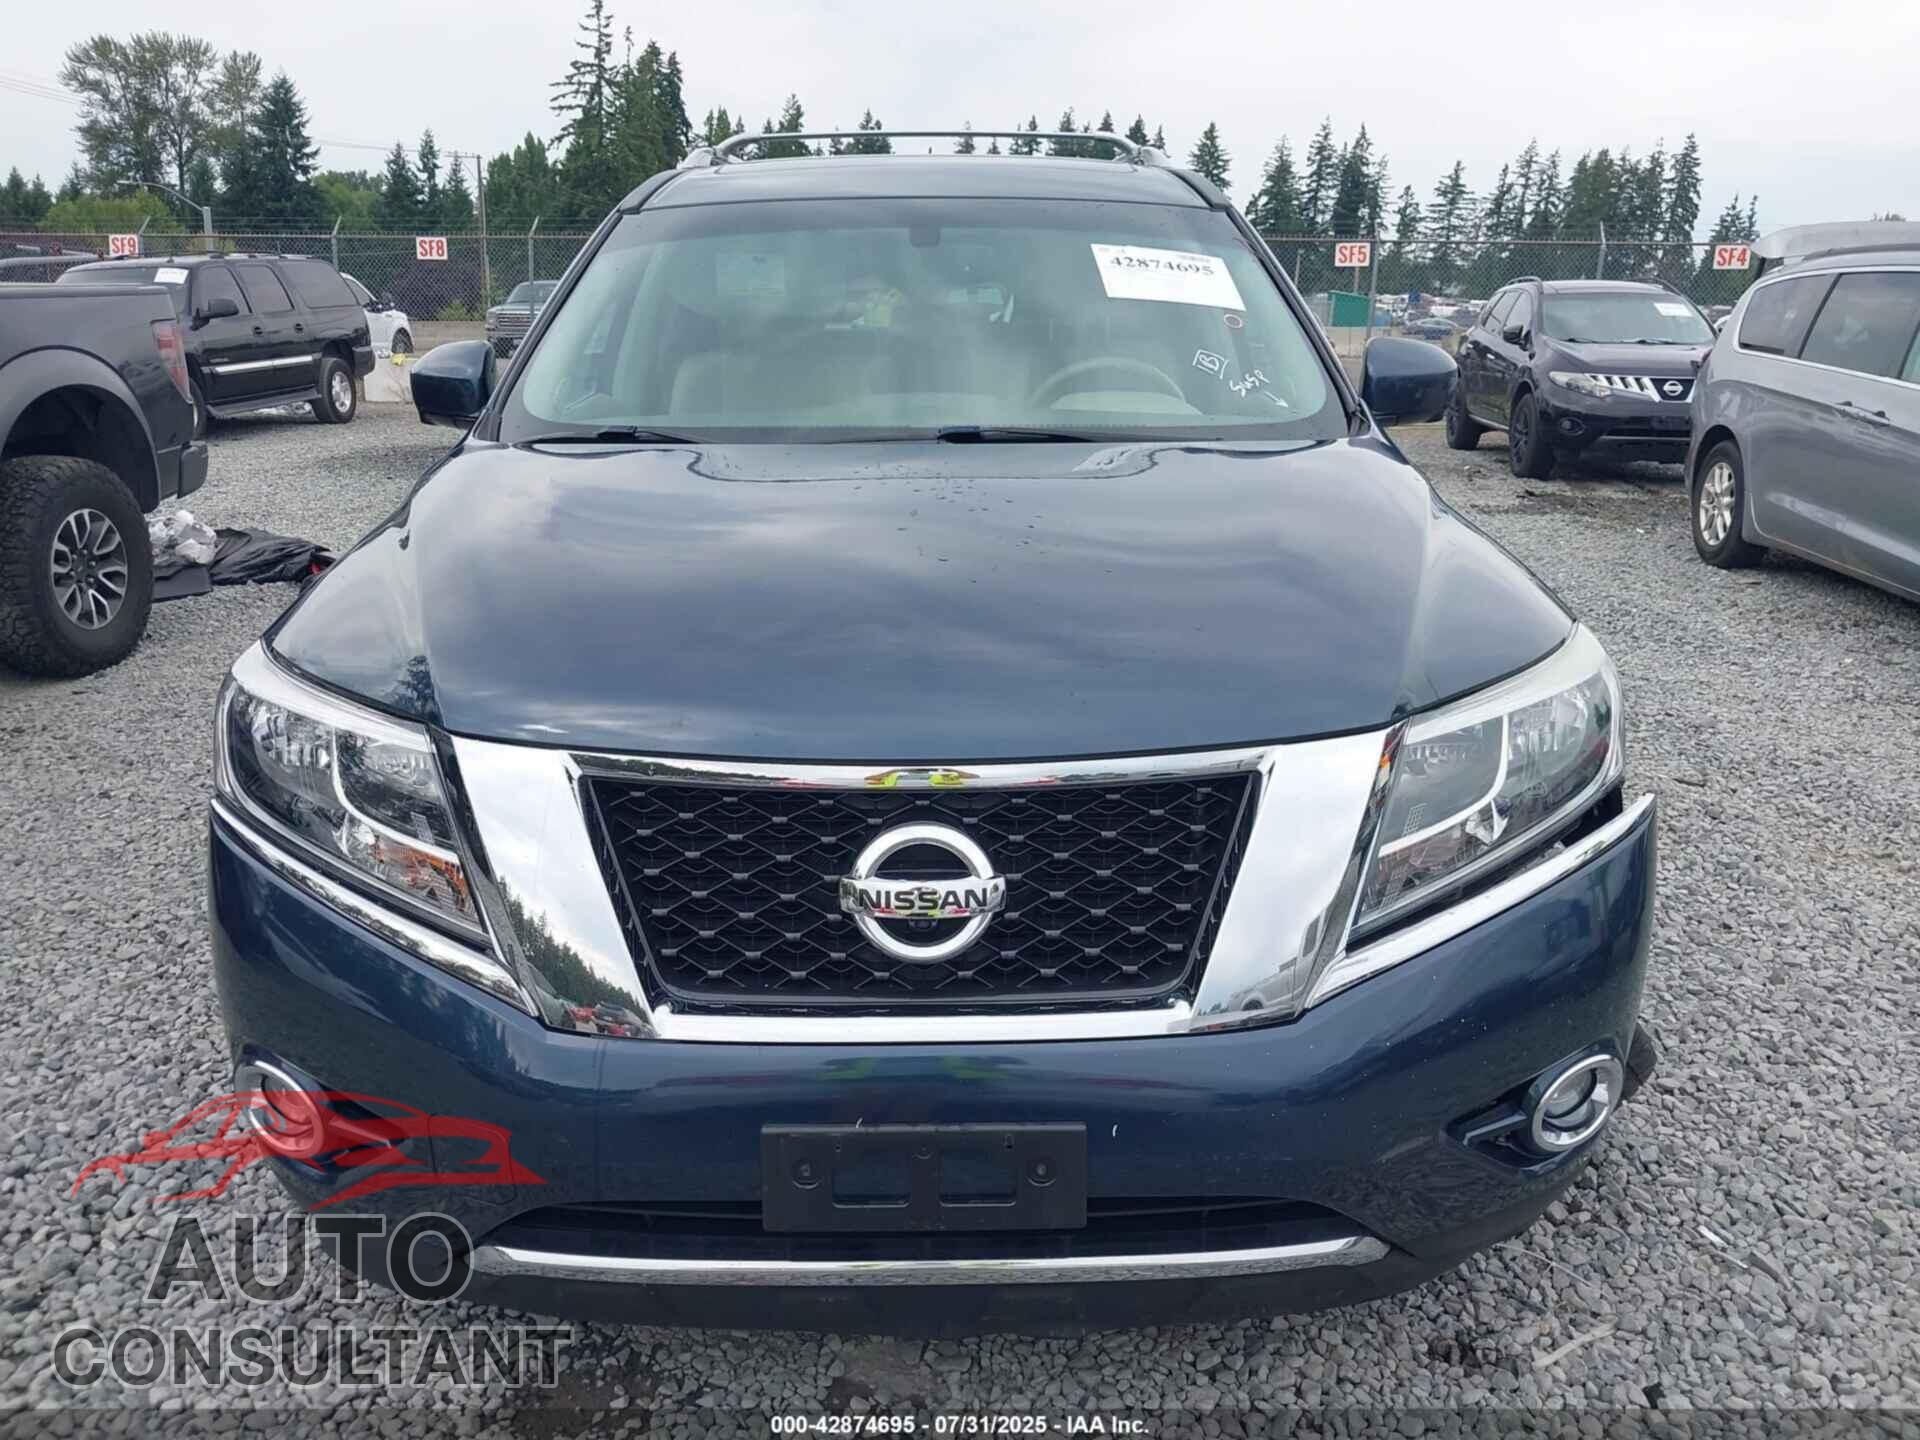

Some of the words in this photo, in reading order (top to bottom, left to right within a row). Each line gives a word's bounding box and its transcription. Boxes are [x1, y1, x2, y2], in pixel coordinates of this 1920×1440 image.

[111, 236, 137, 255] SF9
[419, 239, 445, 257] SF8
[1338, 244, 1368, 264] SF5
[1110, 255, 1215, 277] 42874695
[1716, 247, 1748, 267] SF4
[858, 887, 988, 911] NISSAN
